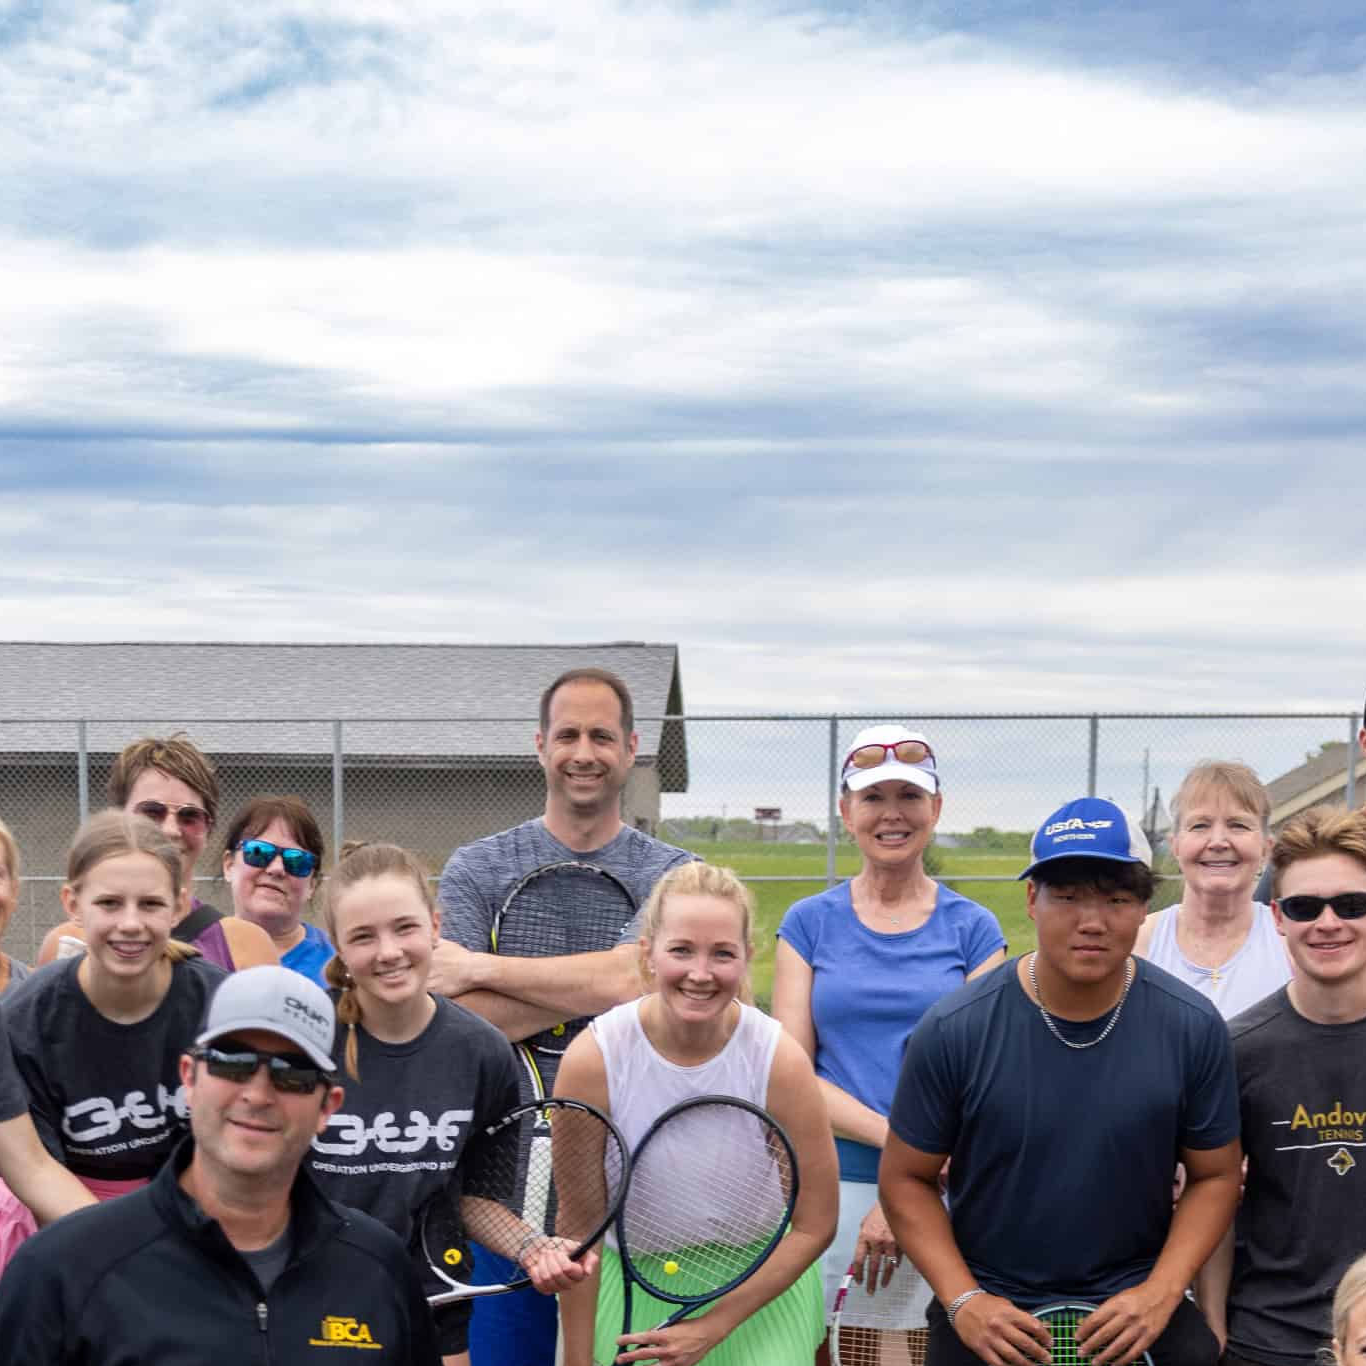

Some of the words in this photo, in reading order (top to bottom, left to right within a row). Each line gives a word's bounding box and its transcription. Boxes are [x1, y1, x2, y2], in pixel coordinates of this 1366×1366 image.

[1318, 1128, 1364, 1141] TENNIS
[311, 1160, 369, 1175] OPERATION
[369, 1162, 438, 1174] UNDERGROUND
[330, 1322, 374, 1343] BCA
